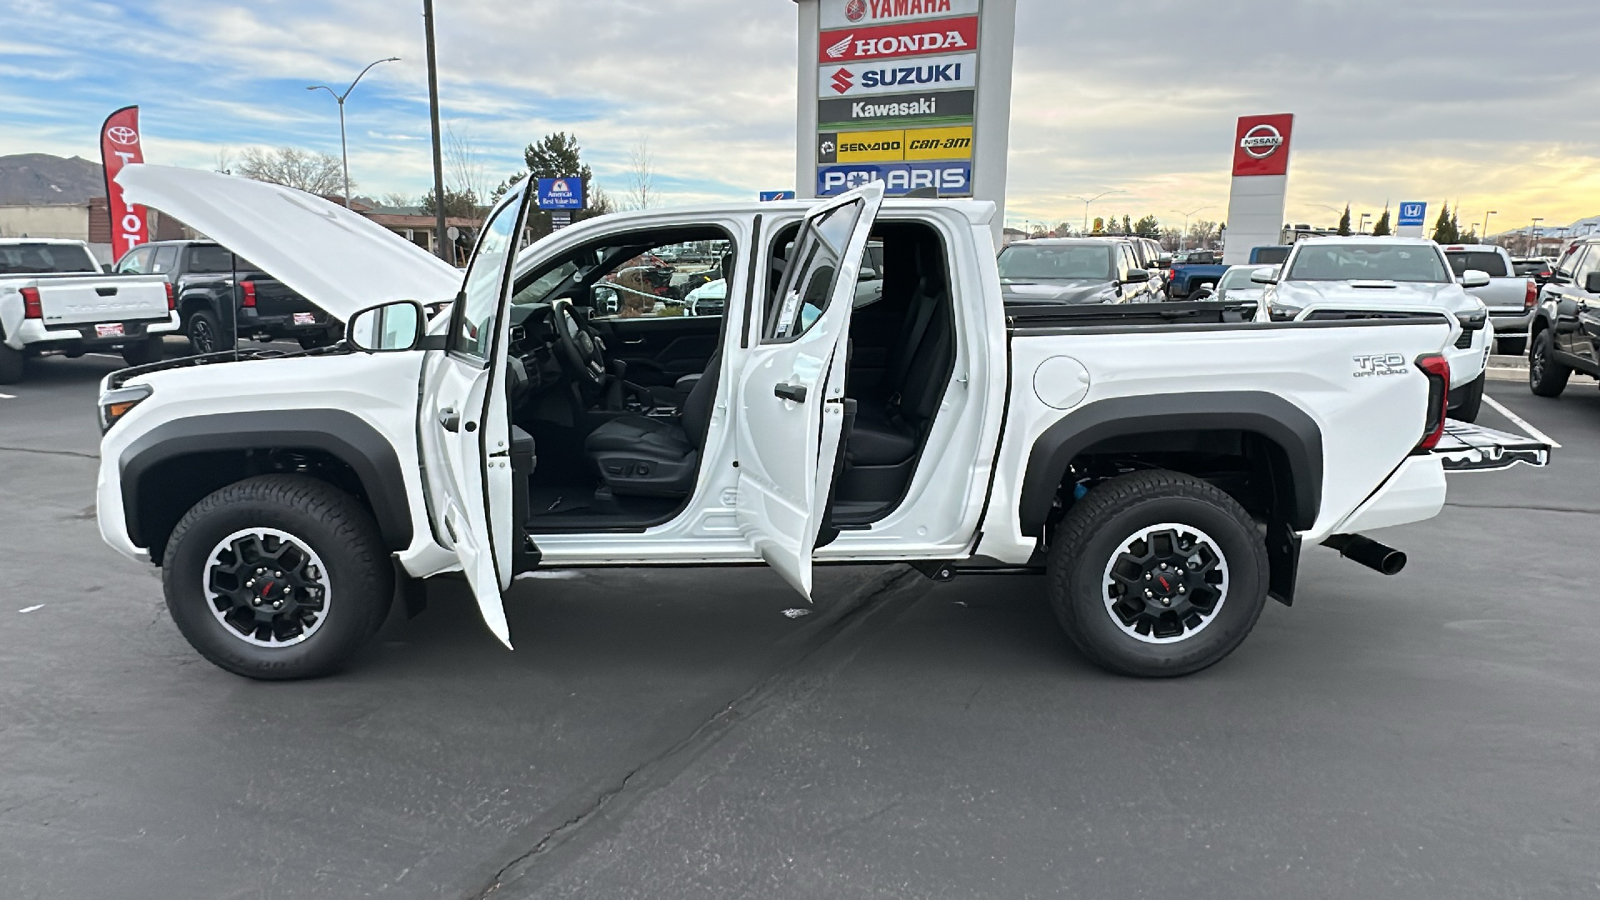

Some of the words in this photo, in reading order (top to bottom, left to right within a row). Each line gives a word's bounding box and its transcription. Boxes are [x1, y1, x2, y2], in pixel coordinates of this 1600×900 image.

[869, 0, 951, 19] YAMAHA
[854, 31, 967, 56] HONDA
[861, 63, 961, 88] SUZUKI
[852, 97, 936, 118] Kawasaki
[1353, 353, 1405, 371] TRD
